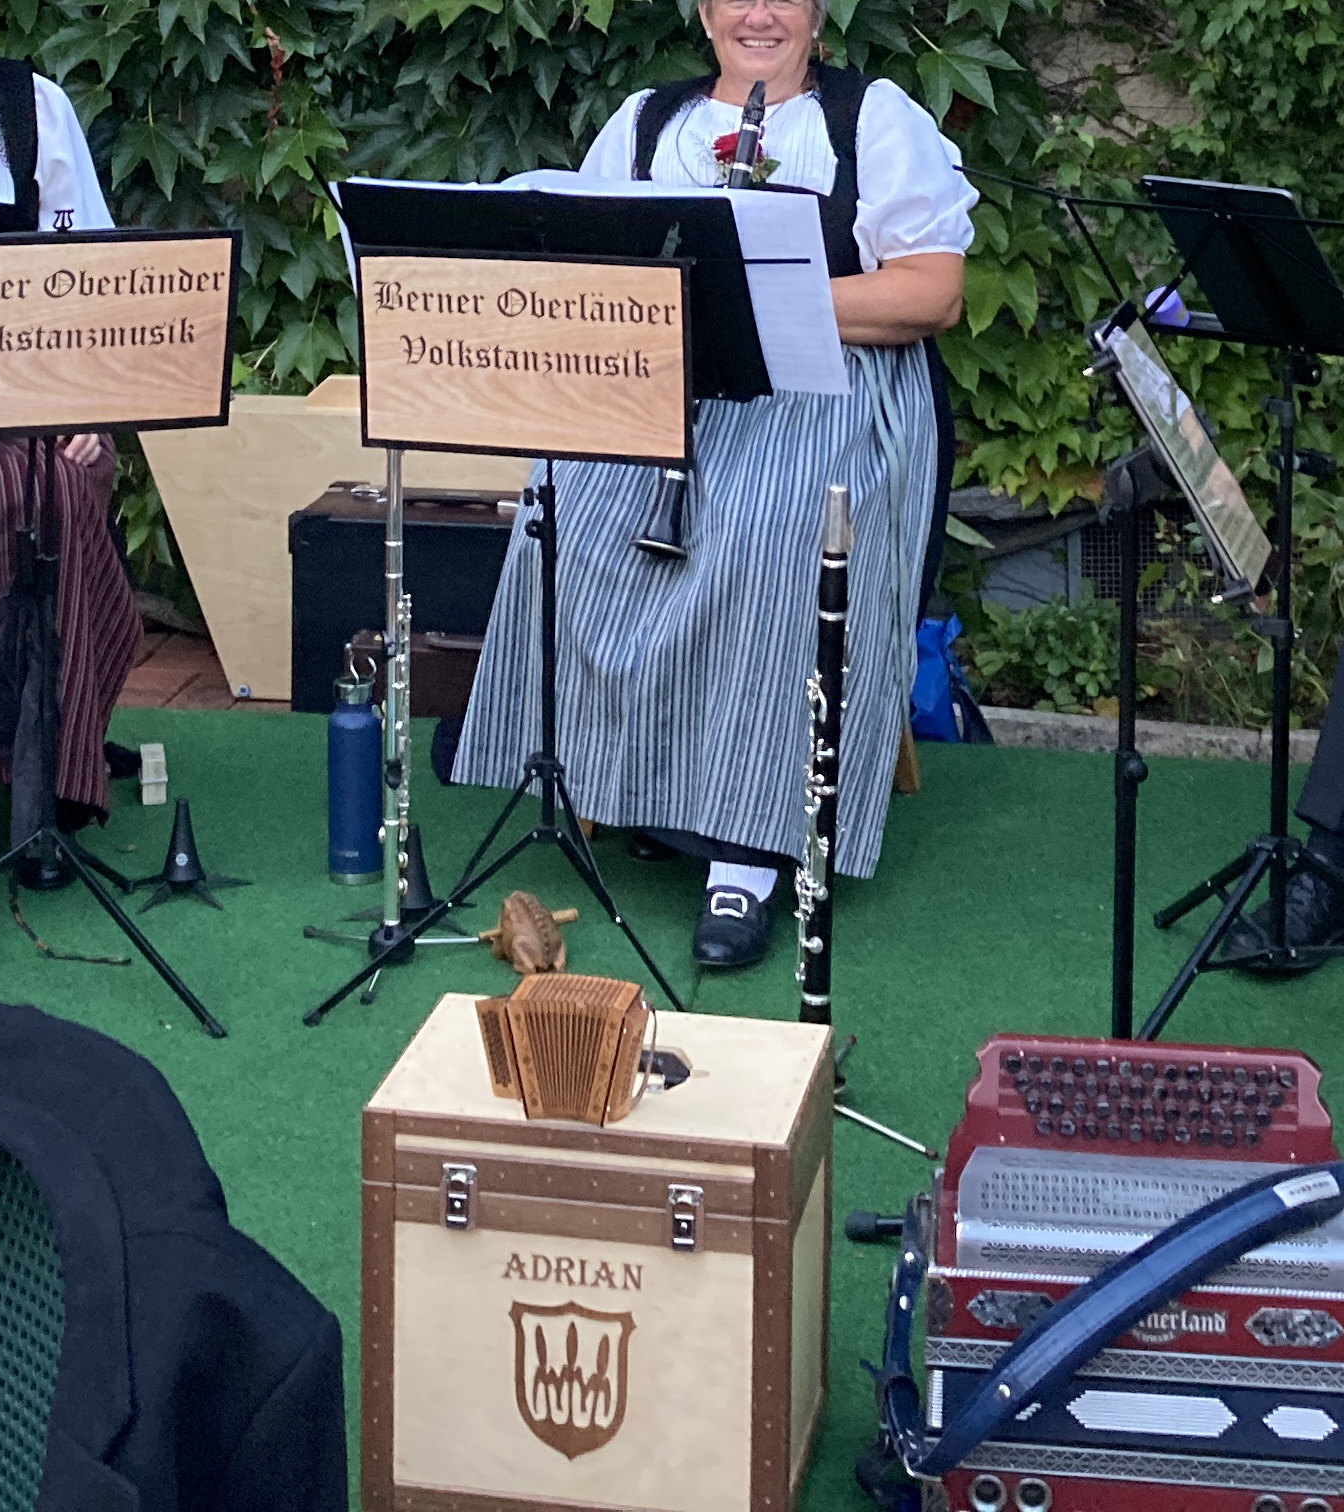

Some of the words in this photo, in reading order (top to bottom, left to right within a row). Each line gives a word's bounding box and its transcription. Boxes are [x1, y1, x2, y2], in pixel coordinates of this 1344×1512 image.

[43, 266, 226, 299] Oberländer
[373, 281, 485, 316] Berner
[496, 287, 677, 325] Oberländer
[399, 334, 651, 378] Volkstanzmusik
[501, 1252, 643, 1291] ADRIAN
